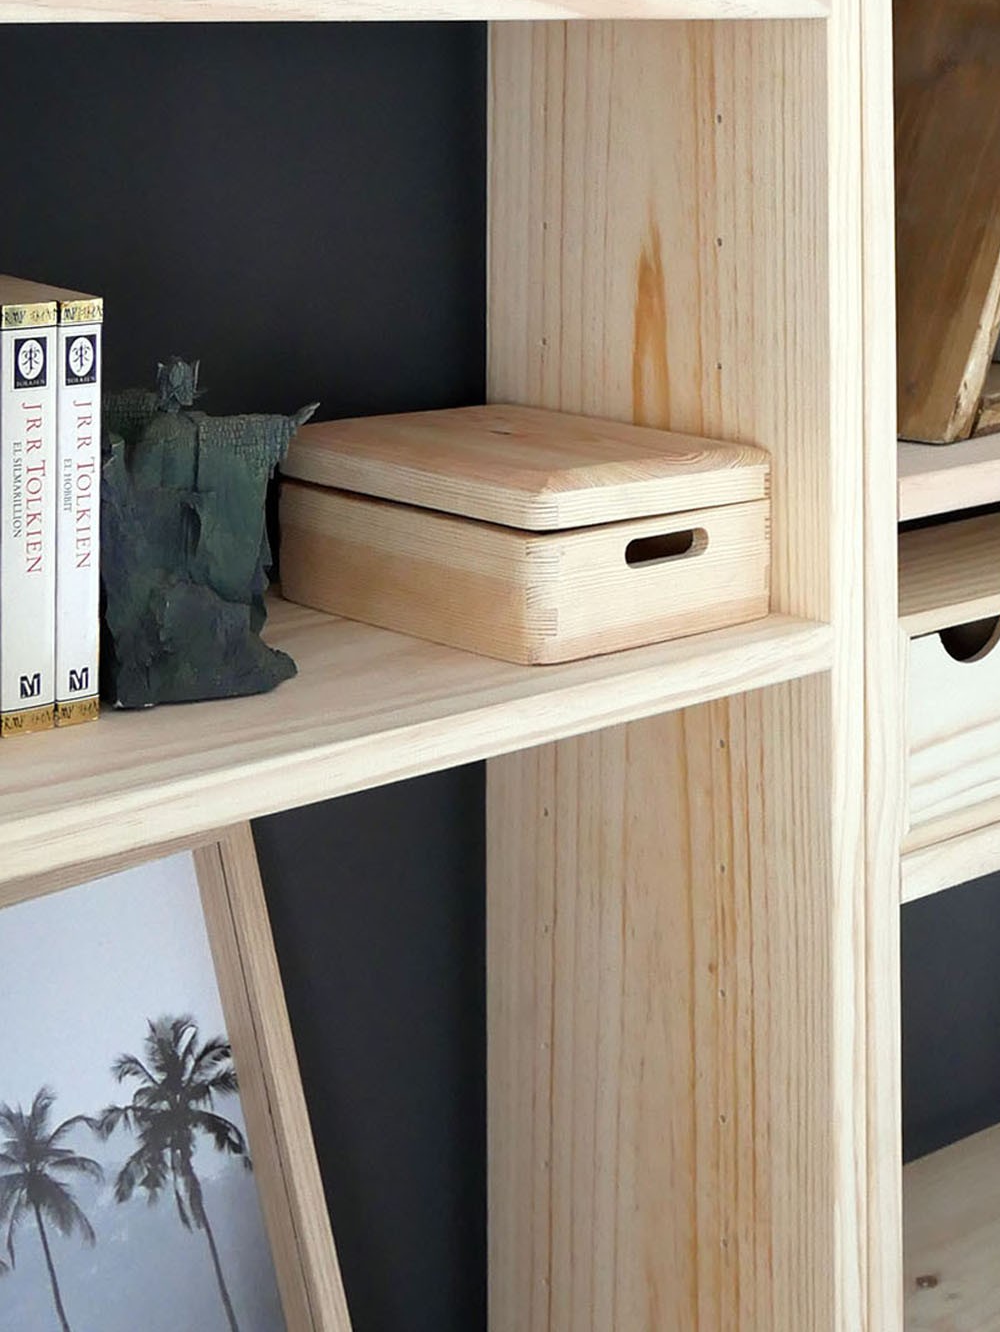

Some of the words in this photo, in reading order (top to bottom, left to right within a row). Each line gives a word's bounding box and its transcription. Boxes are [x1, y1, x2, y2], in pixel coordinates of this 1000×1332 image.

[26, 459, 46, 572] TOLKIEN
[63, 473, 72, 512] HOBBIT
[76, 456, 96, 568] TOLKIEN
